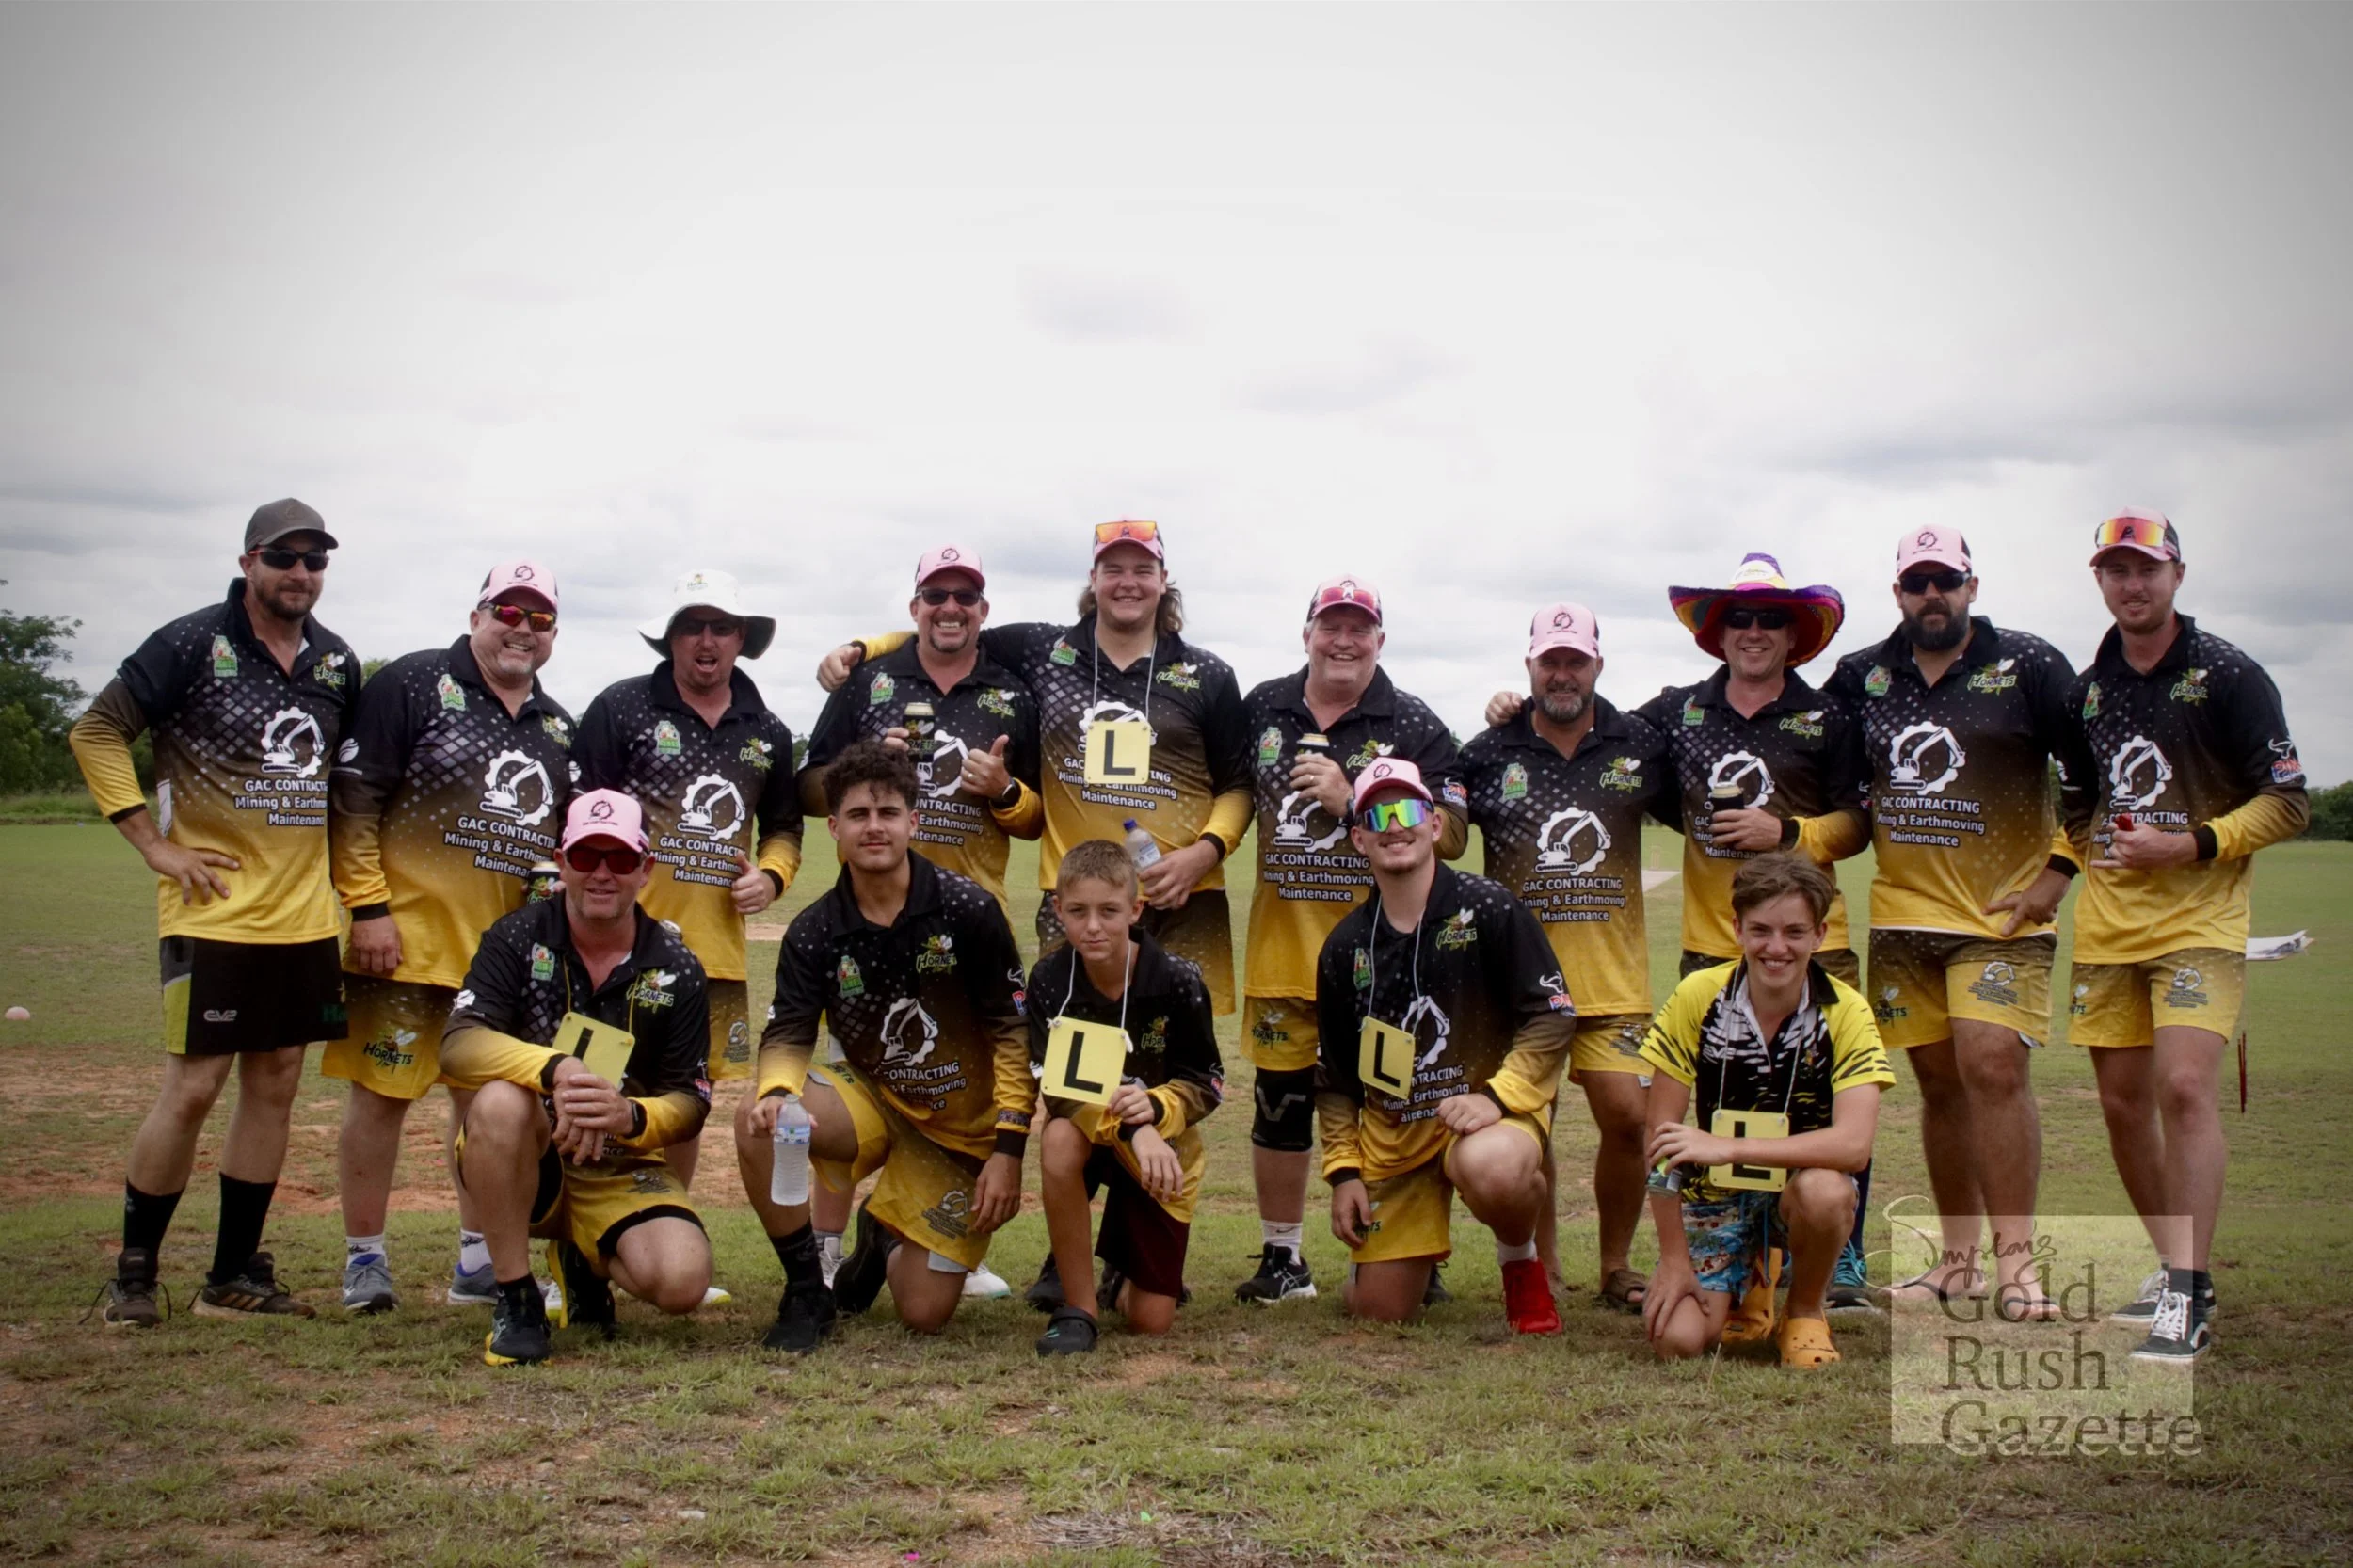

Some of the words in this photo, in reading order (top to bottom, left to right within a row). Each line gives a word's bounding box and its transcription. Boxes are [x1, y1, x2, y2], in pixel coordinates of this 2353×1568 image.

[1967, 673, 2017, 691] HORNETS
[1103, 729, 1136, 776] L
[1064, 757, 1085, 770] GAC
[245, 779, 272, 792] GAC
[275, 779, 328, 793] CONTRACT
[1600, 769, 1643, 789] HORNETS
[235, 797, 279, 810] Mining
[281, 797, 292, 808] &
[294, 797, 327, 809] Earthm
[1082, 790, 1157, 810] Maintenance
[1895, 797, 1980, 814] CONTRACTING
[268, 813, 325, 826] Maintenan
[920, 813, 984, 835] Earthmoving
[1695, 816, 1710, 827] GAC
[1898, 815, 1907, 825] &
[1909, 815, 1985, 835] Earthmoving
[457, 816, 487, 832] GAC
[489, 821, 556, 847] CONTRACTIN
[910, 830, 964, 845] ntenance
[1890, 830, 1959, 847] Maintenance
[444, 832, 489, 852] Mining
[492, 840, 503, 853] &
[660, 837, 683, 849] GAC
[686, 840, 742, 856] CONTRACT
[1265, 853, 1280, 865] GAC
[1282, 853, 1369, 869] CONTRACTING
[1705, 846, 1757, 859] Maintenan
[474, 856, 532, 877] Maintena
[689, 856, 698, 867] &
[675, 870, 733, 887] Maintenanc
[1287, 871, 1296, 881] &
[1300, 871, 1375, 887] Earthmoving
[1523, 879, 1544, 892] GAC
[1546, 878, 1623, 890] CONTRACTING
[1278, 888, 1353, 901] Maintenance
[1521, 897, 1549, 909] ining
[1553, 895, 1561, 905] &
[1564, 894, 1626, 908] Earthmoving
[1541, 910, 1610, 922] Maintenance
[363, 1041, 414, 1066] HORNETS
[1373, 1029, 1401, 1088] L
[1064, 1030, 1104, 1095] L
[1412, 1064, 1464, 1087] NTRACTING
[1732, 1121, 1771, 1180] L
